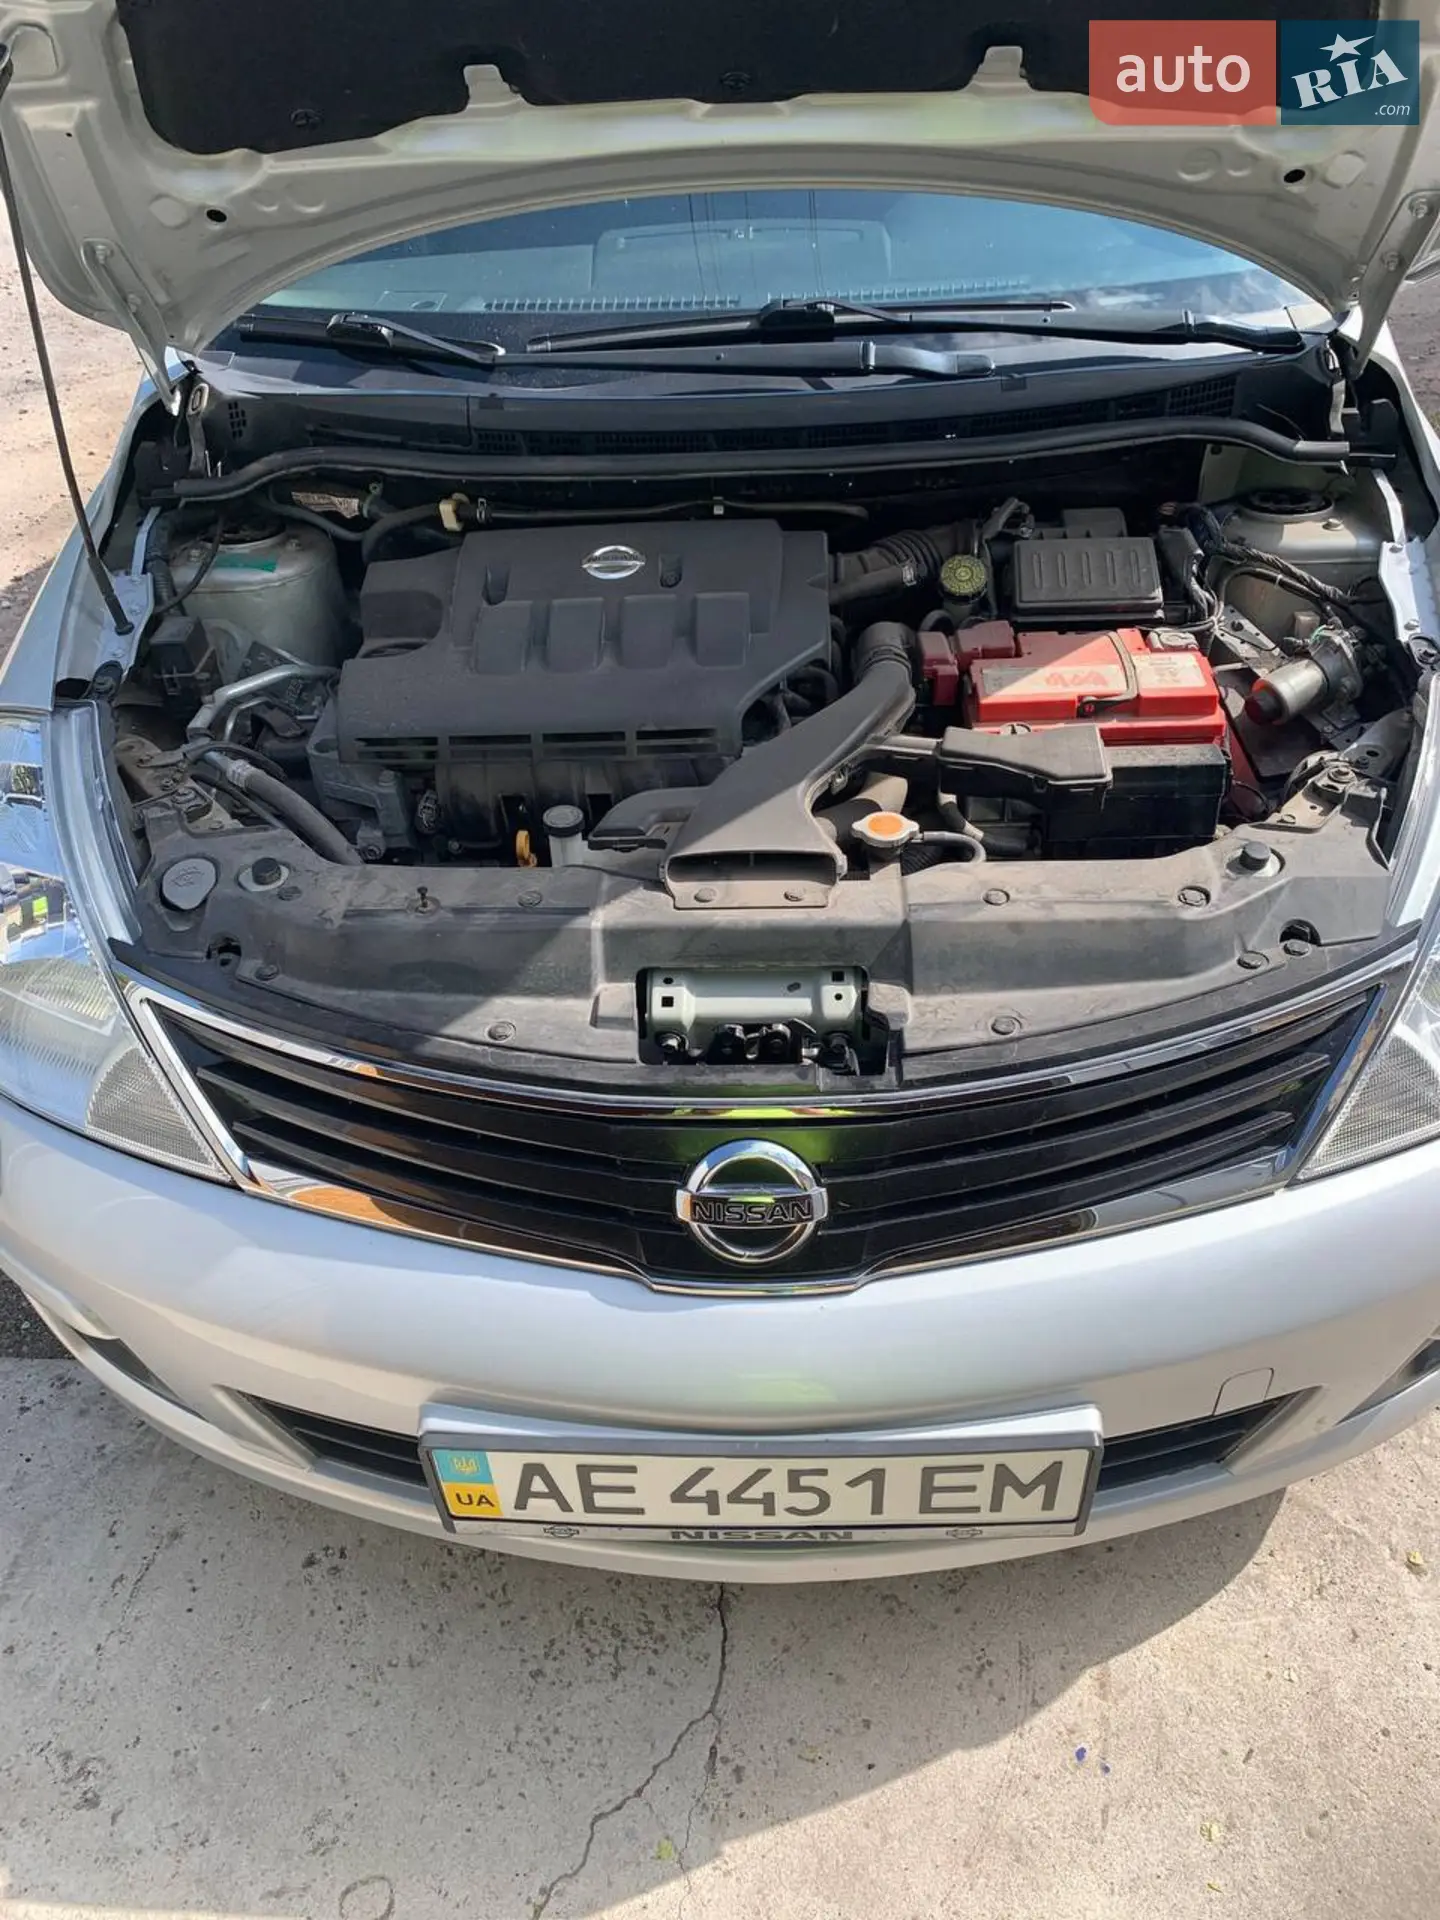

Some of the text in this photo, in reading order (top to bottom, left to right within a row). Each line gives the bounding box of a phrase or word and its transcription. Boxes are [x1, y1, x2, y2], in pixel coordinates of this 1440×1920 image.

[694, 1200, 812, 1223] NISSAN
[514, 1461, 1063, 1516] AE 4451 EM
[455, 1492, 495, 1508] UA
[671, 1530, 852, 1540] NISSAN
